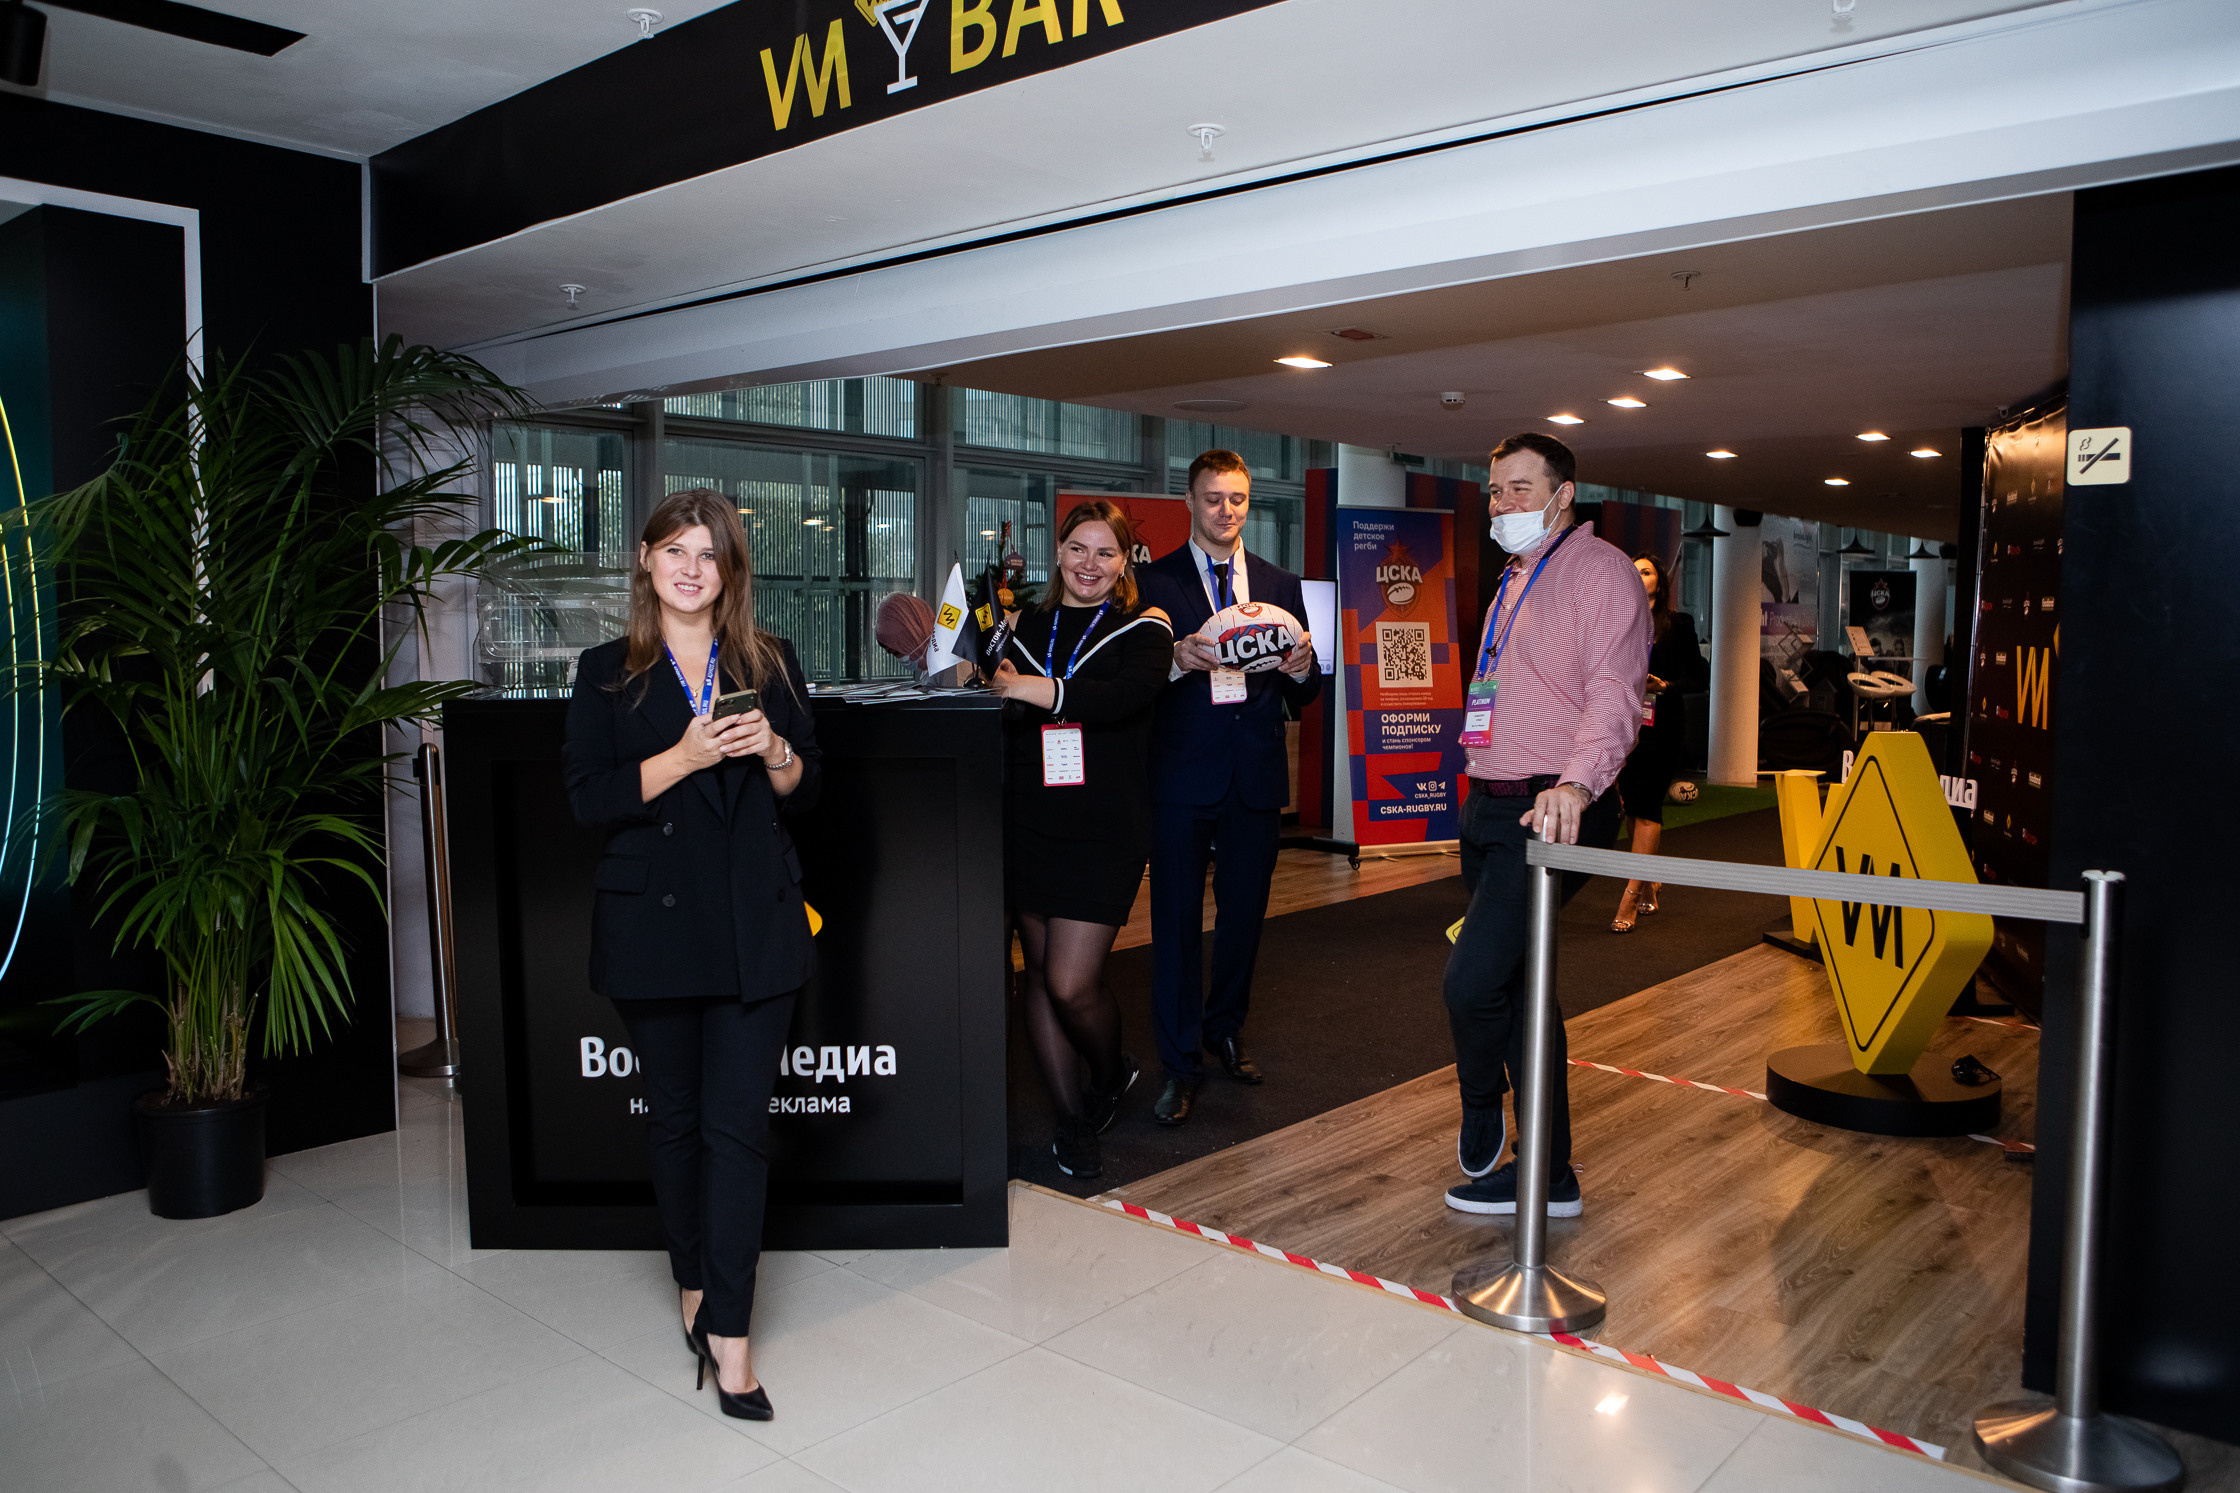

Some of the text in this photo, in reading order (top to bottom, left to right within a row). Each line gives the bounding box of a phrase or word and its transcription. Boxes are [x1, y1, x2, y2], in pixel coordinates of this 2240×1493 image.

[1352, 520, 1395, 531] Поддержи
[1353, 532, 1385, 541] детское
[1354, 541, 1377, 551] регби
[1132, 544, 1153, 564] КА
[1376, 565, 1424, 584] ЦСКА
[1215, 625, 1296, 664] ЦСКА
[1381, 713, 1430, 724] ОФОРМИ
[1381, 724, 1442, 737] ПОДПИСКУ
[1401, 736, 1431, 744] спонсором
[1380, 803, 1447, 815] CSKA-RUGBY.RU
